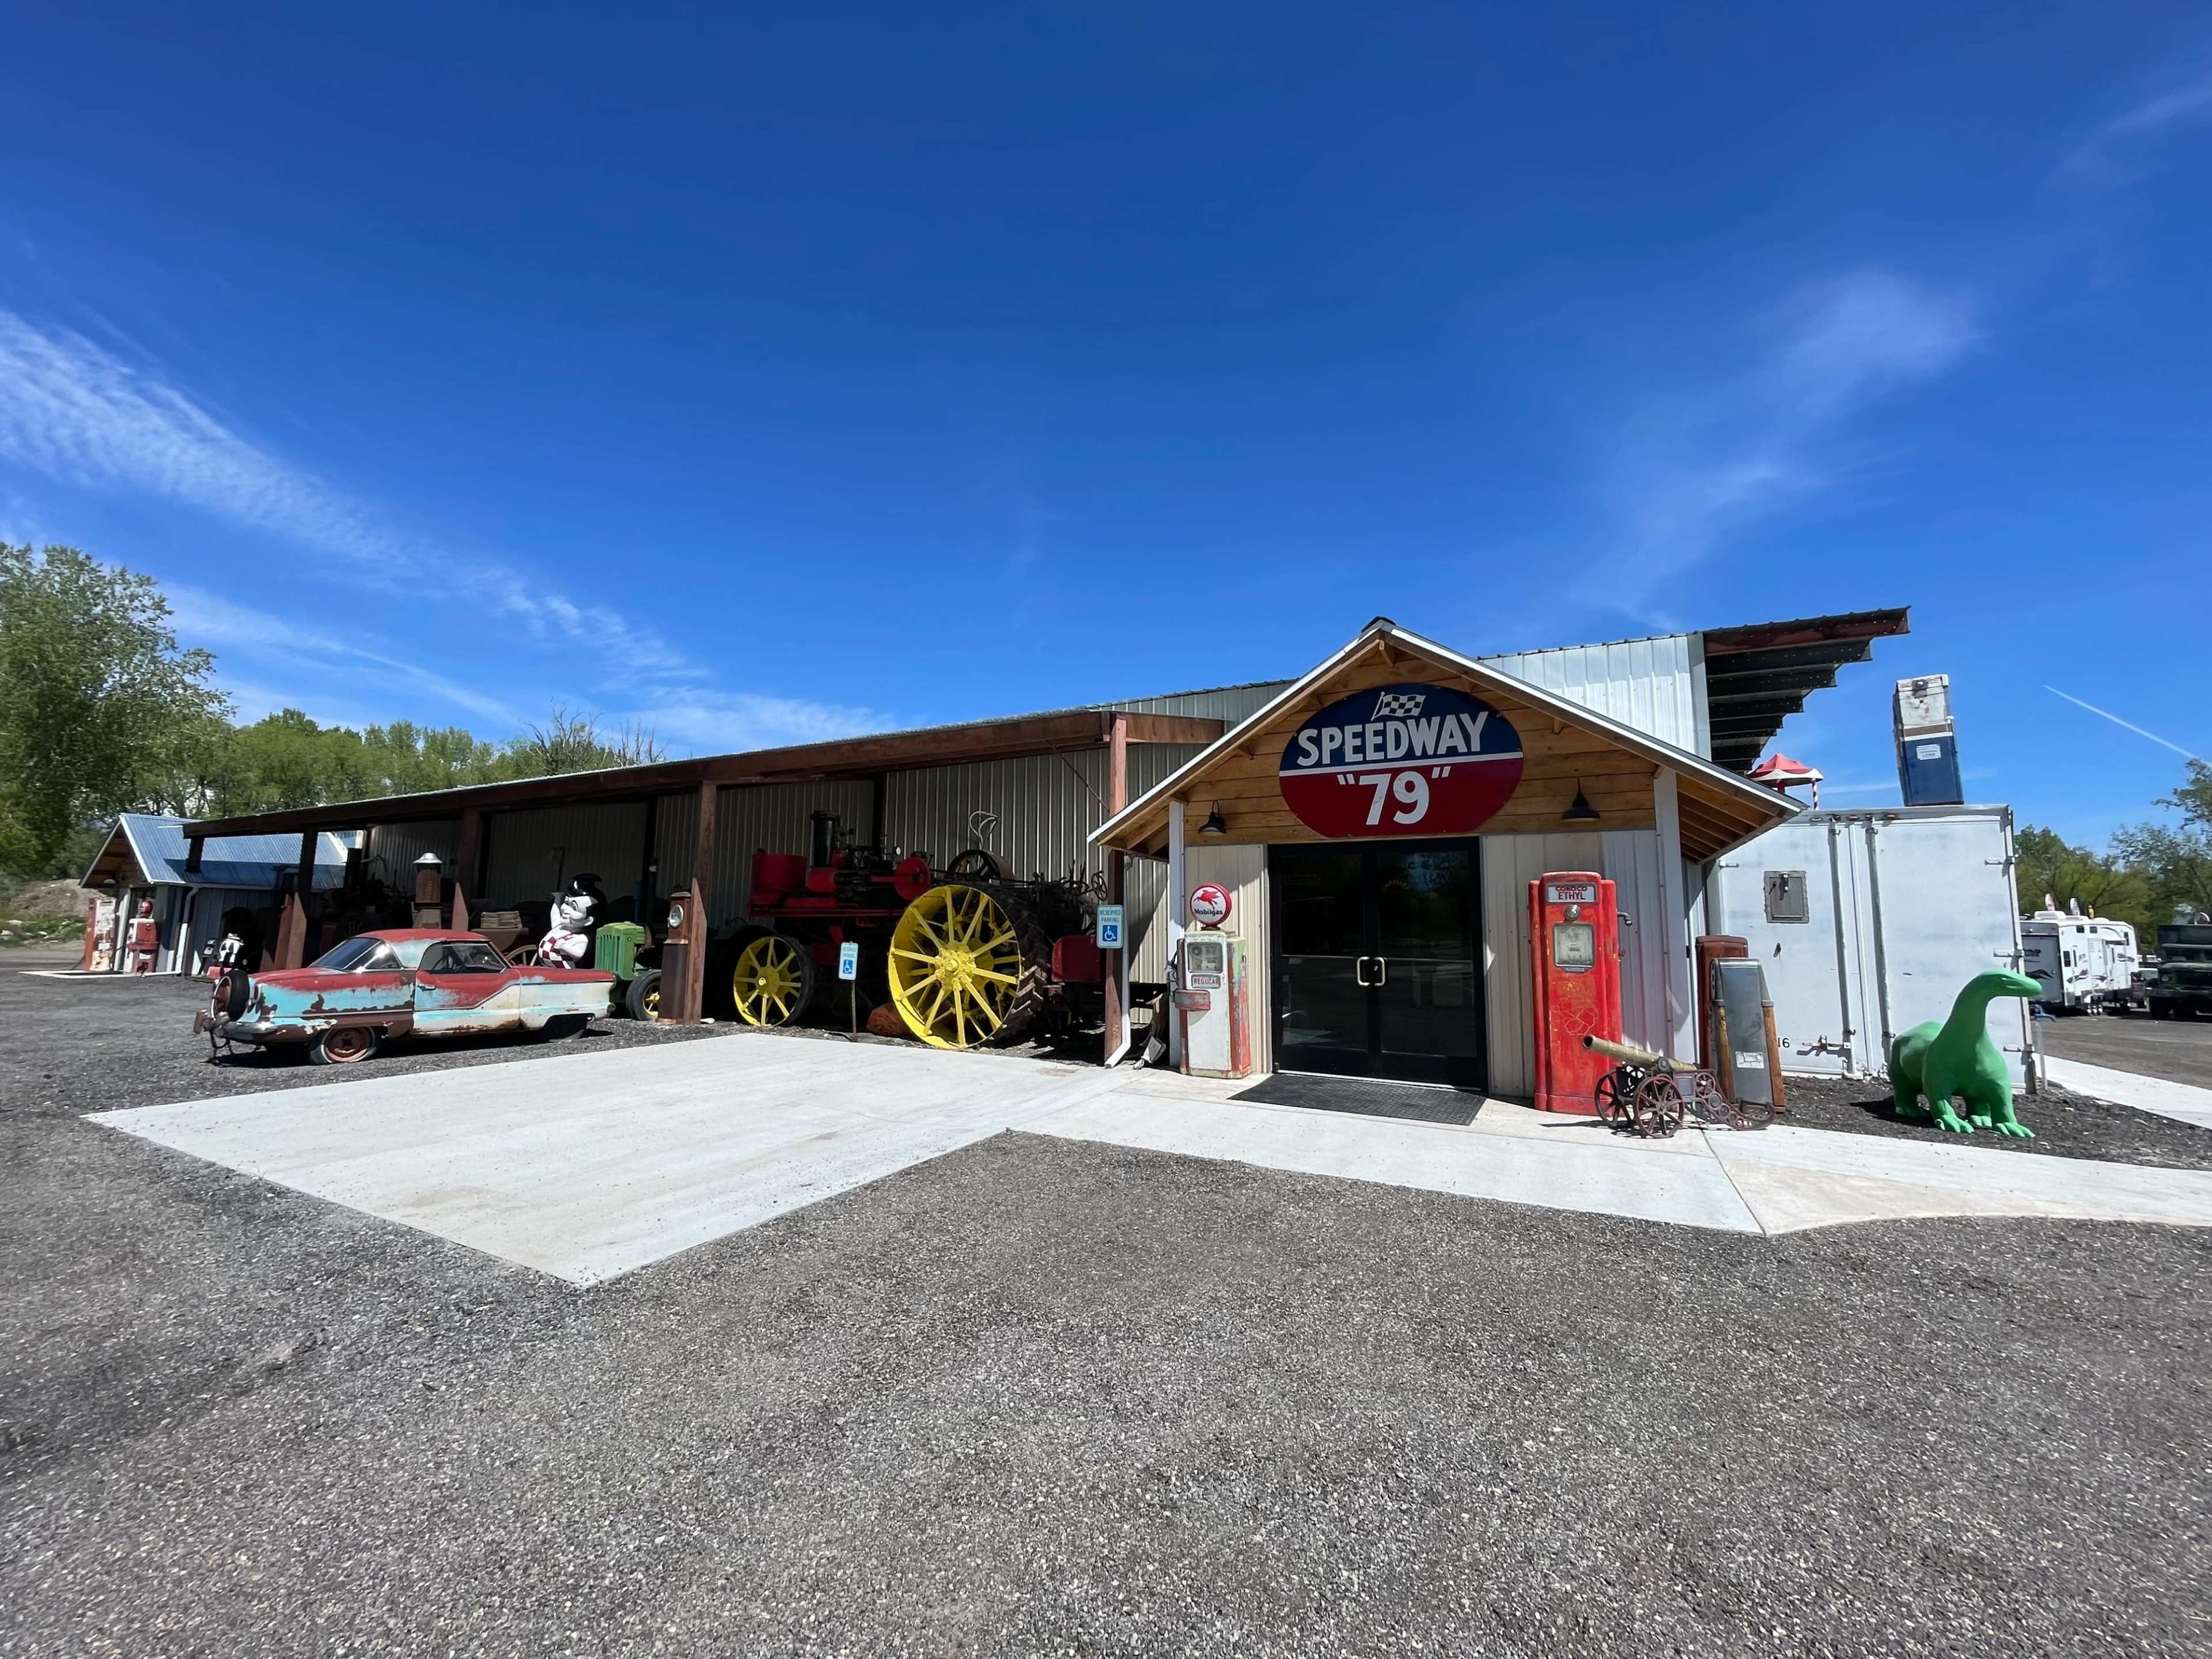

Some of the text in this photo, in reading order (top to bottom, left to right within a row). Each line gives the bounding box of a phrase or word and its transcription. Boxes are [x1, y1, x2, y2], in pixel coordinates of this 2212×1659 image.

[1297, 711, 1488, 767] SPEEDWAY
[1337, 766, 1451, 825] "79"
[1194, 908, 1224, 916] Mobilgas
[1558, 892, 1586, 900] ETHYL
